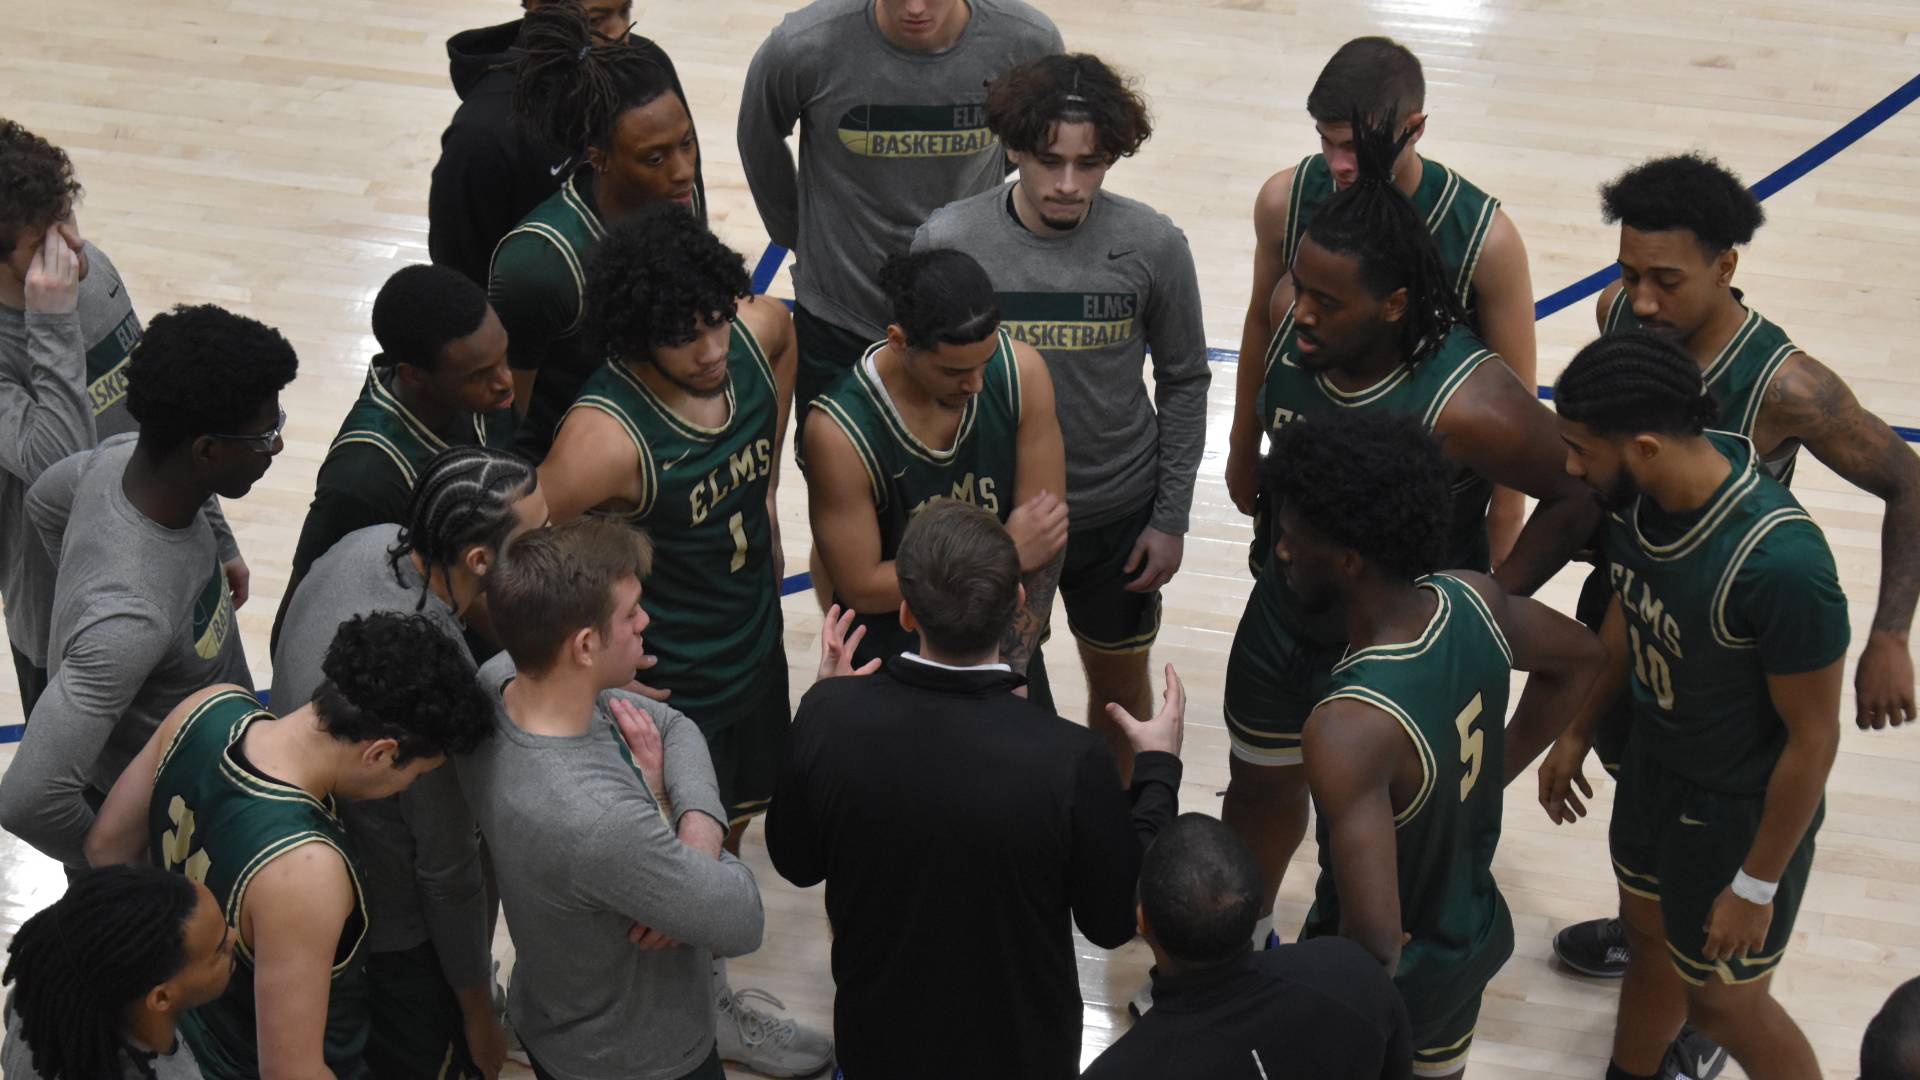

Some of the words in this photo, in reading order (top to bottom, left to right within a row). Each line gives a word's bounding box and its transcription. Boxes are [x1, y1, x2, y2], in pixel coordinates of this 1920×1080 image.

[872, 131, 994, 155] BASKETBAL
[1083, 294, 1134, 320] ELMS
[689, 438, 771, 528] ELMS
[912, 472, 999, 514] MS
[728, 510, 749, 574] 1
[1629, 623, 1675, 711] 10
[1454, 690, 1484, 803] 5
